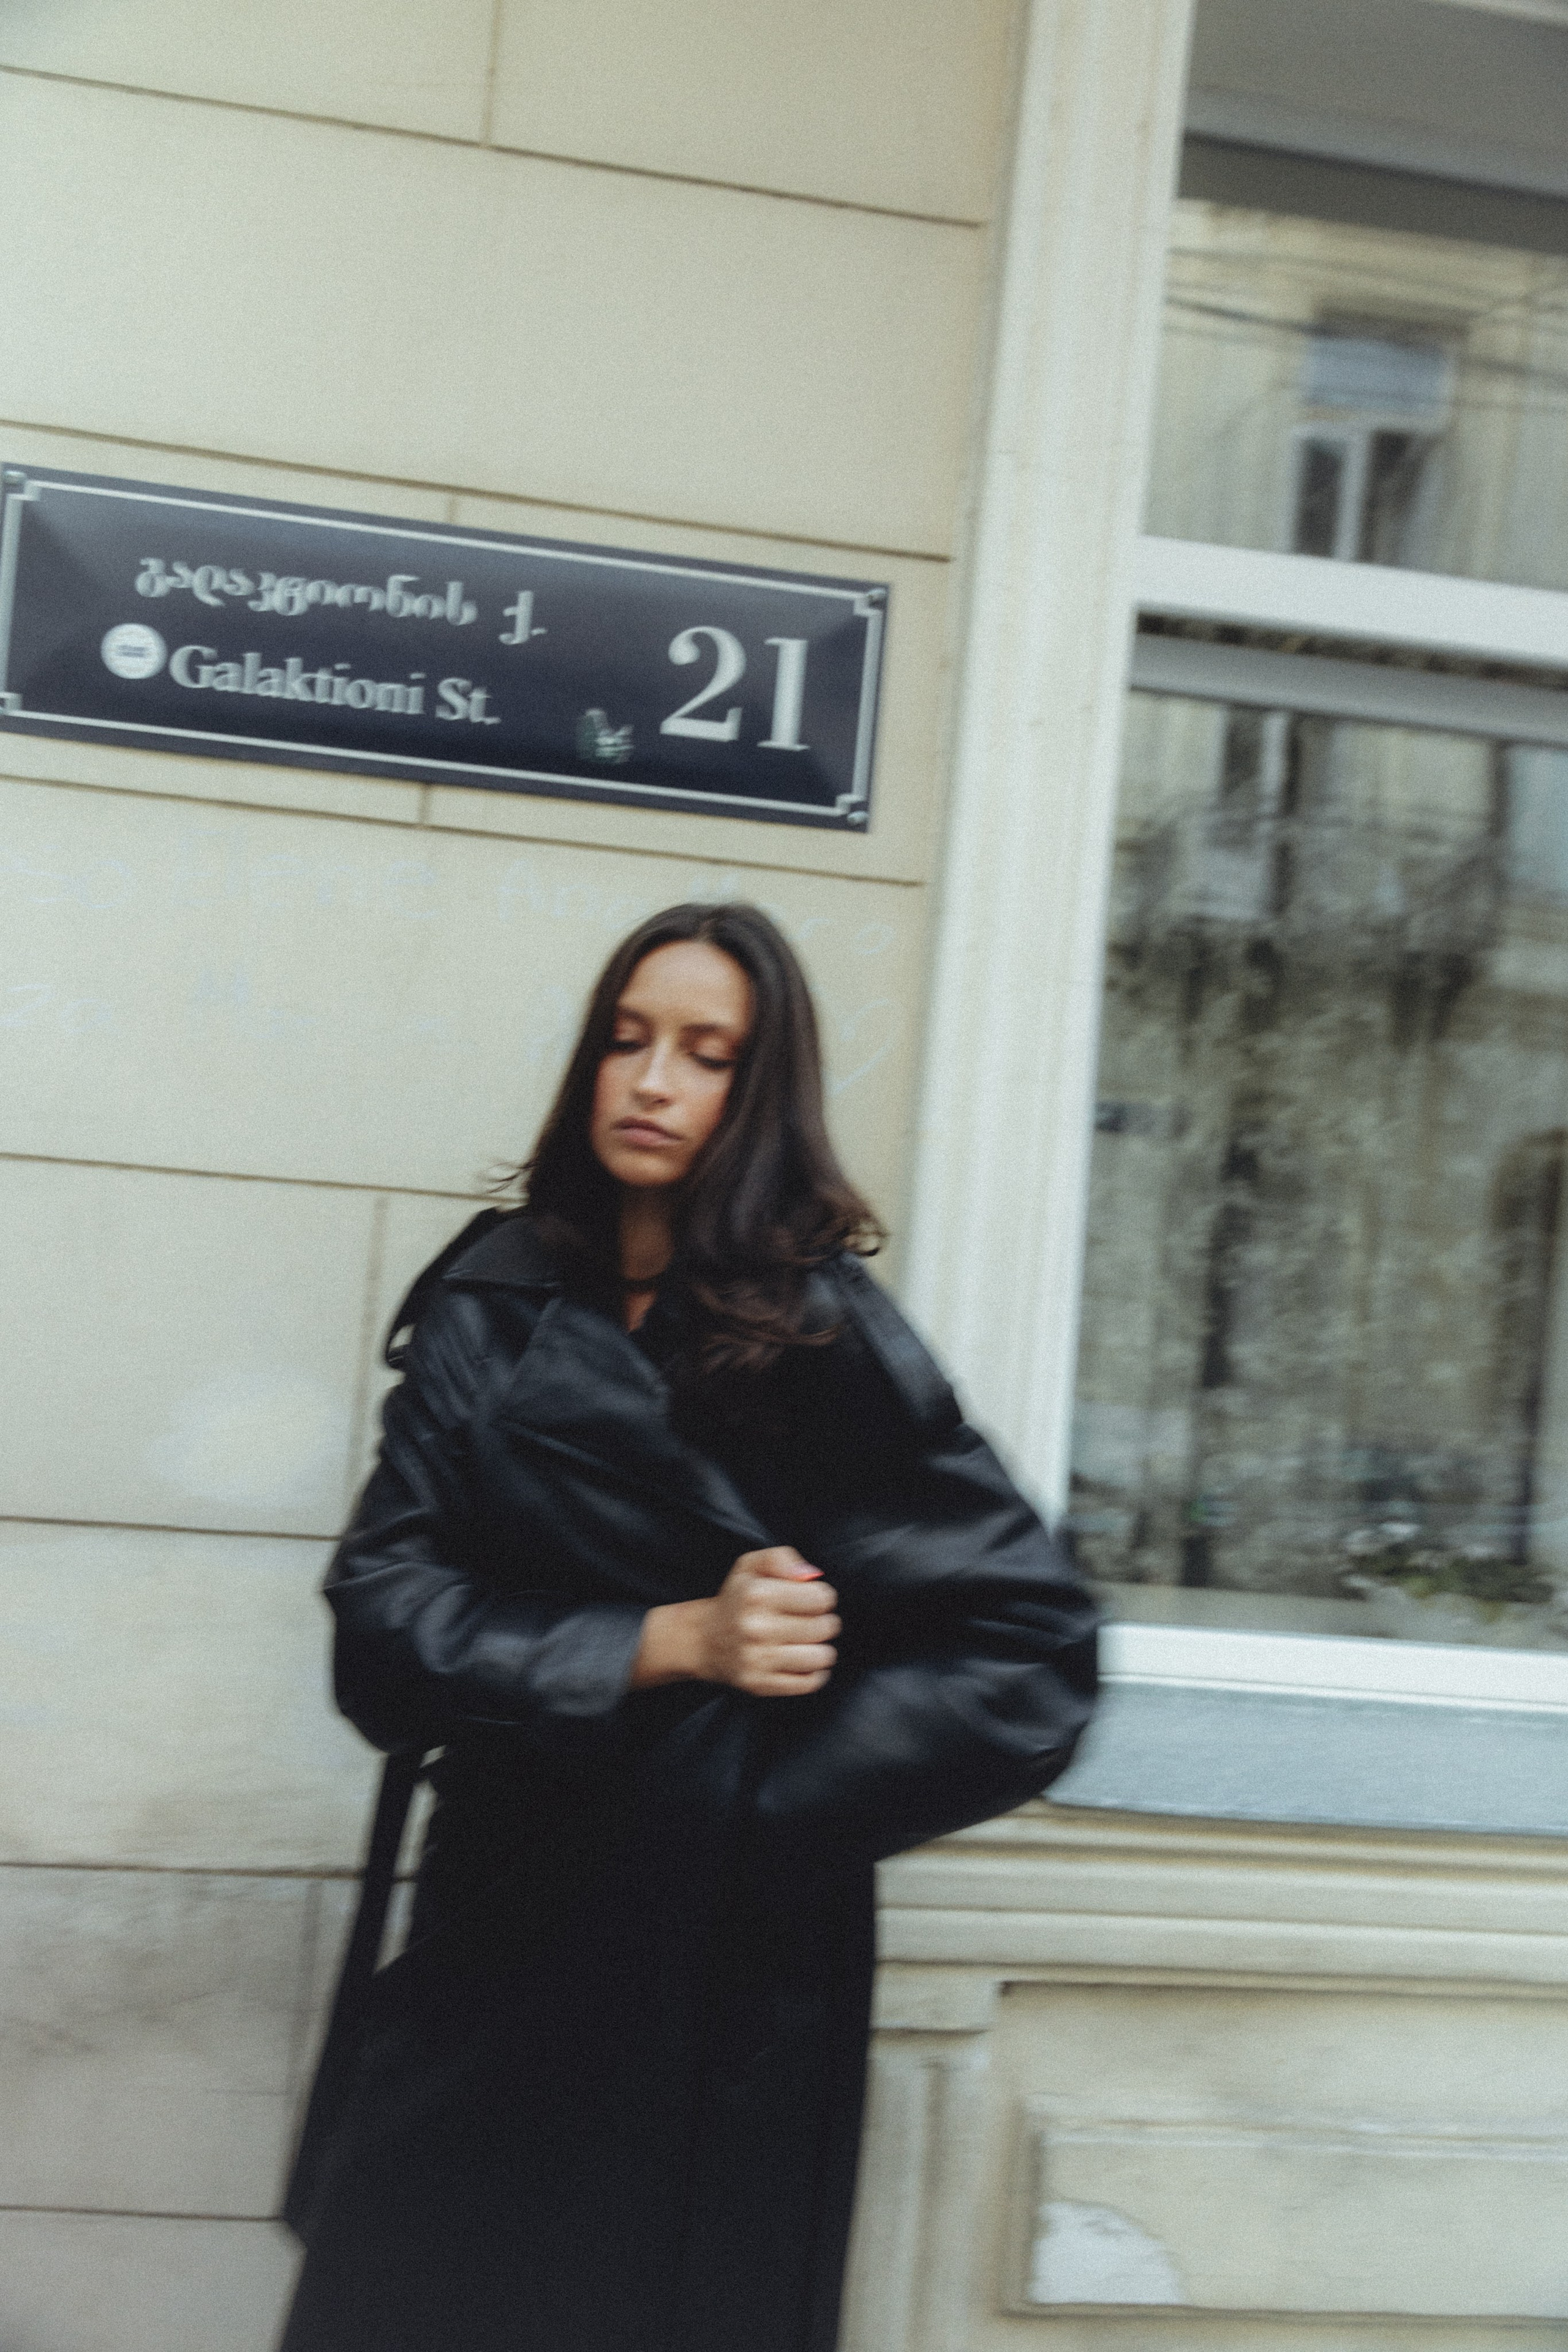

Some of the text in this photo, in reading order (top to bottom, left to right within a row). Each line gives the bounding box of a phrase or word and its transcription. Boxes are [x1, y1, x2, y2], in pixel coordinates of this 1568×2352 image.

[169, 644, 500, 725] Galaktioni St.
[660, 626, 810, 751] 21
